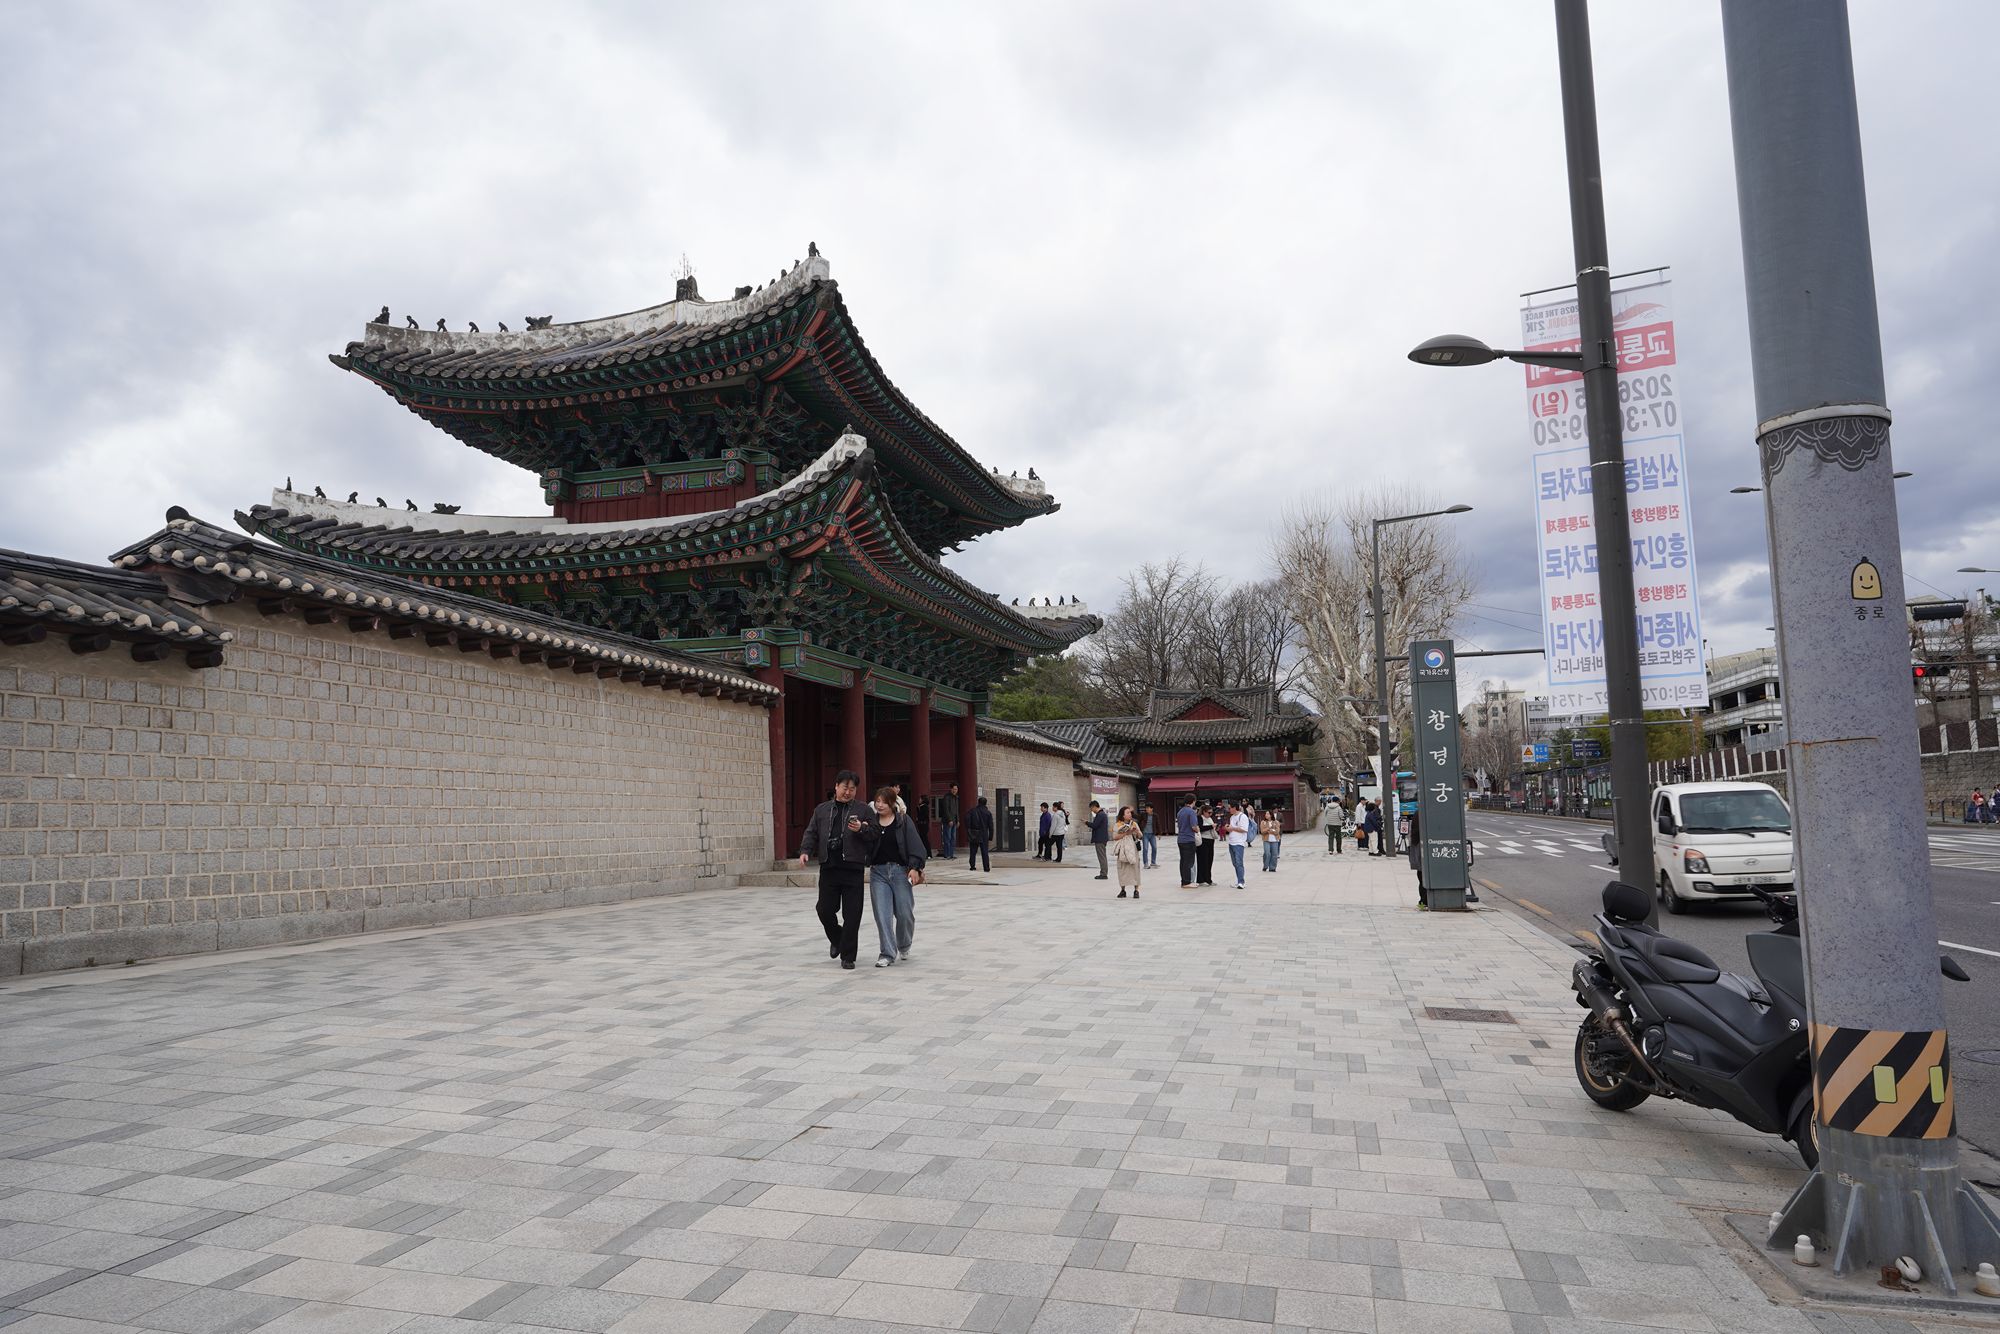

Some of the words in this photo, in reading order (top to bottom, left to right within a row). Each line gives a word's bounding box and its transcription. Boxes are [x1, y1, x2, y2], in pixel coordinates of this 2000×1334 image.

[1853, 605, 1886, 621] 종로
[1419, 668, 1450, 676] 국가유산청
[1427, 708, 1453, 804] 창경궁
[1431, 846, 1460, 859] 昌慶宮
